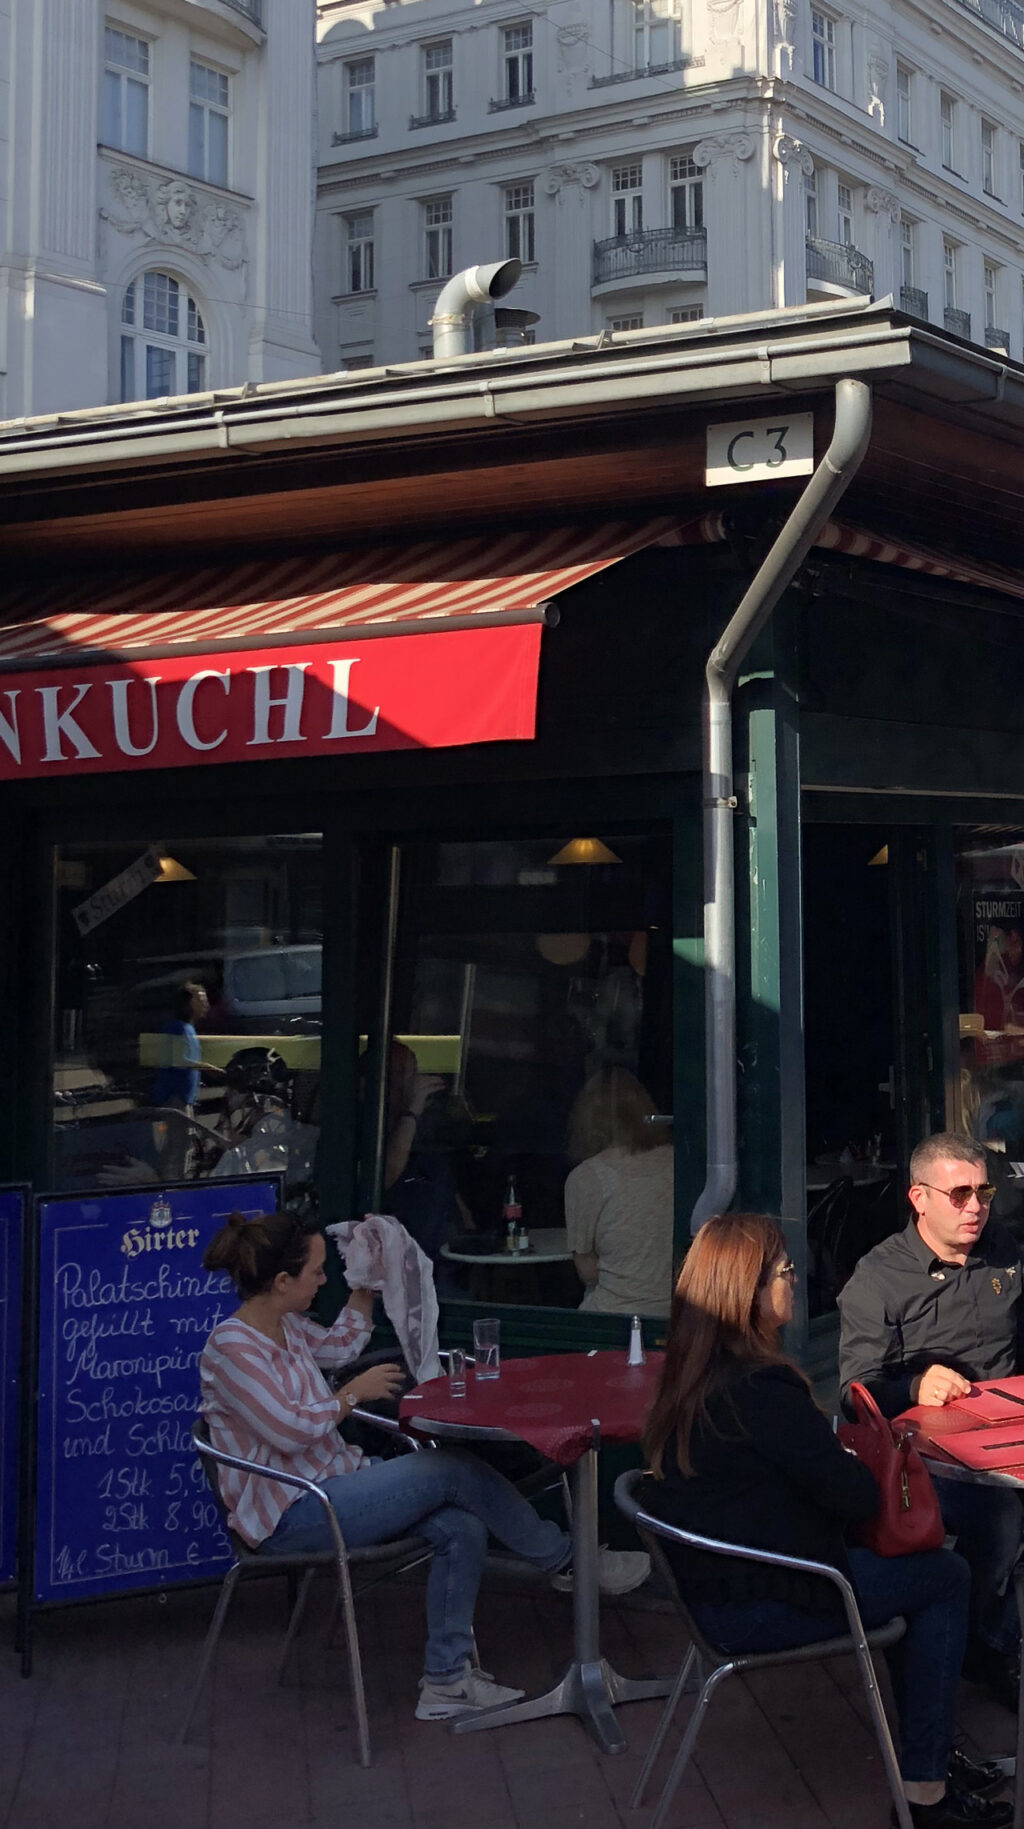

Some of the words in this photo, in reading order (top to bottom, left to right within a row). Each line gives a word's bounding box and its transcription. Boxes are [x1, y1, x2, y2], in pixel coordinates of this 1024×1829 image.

[120, 1226, 200, 1258] Hirter
[56, 1262, 239, 1310] Palatschinke
[168, 1302, 225, 1335] mit
[63, 1423, 116, 1459] und
